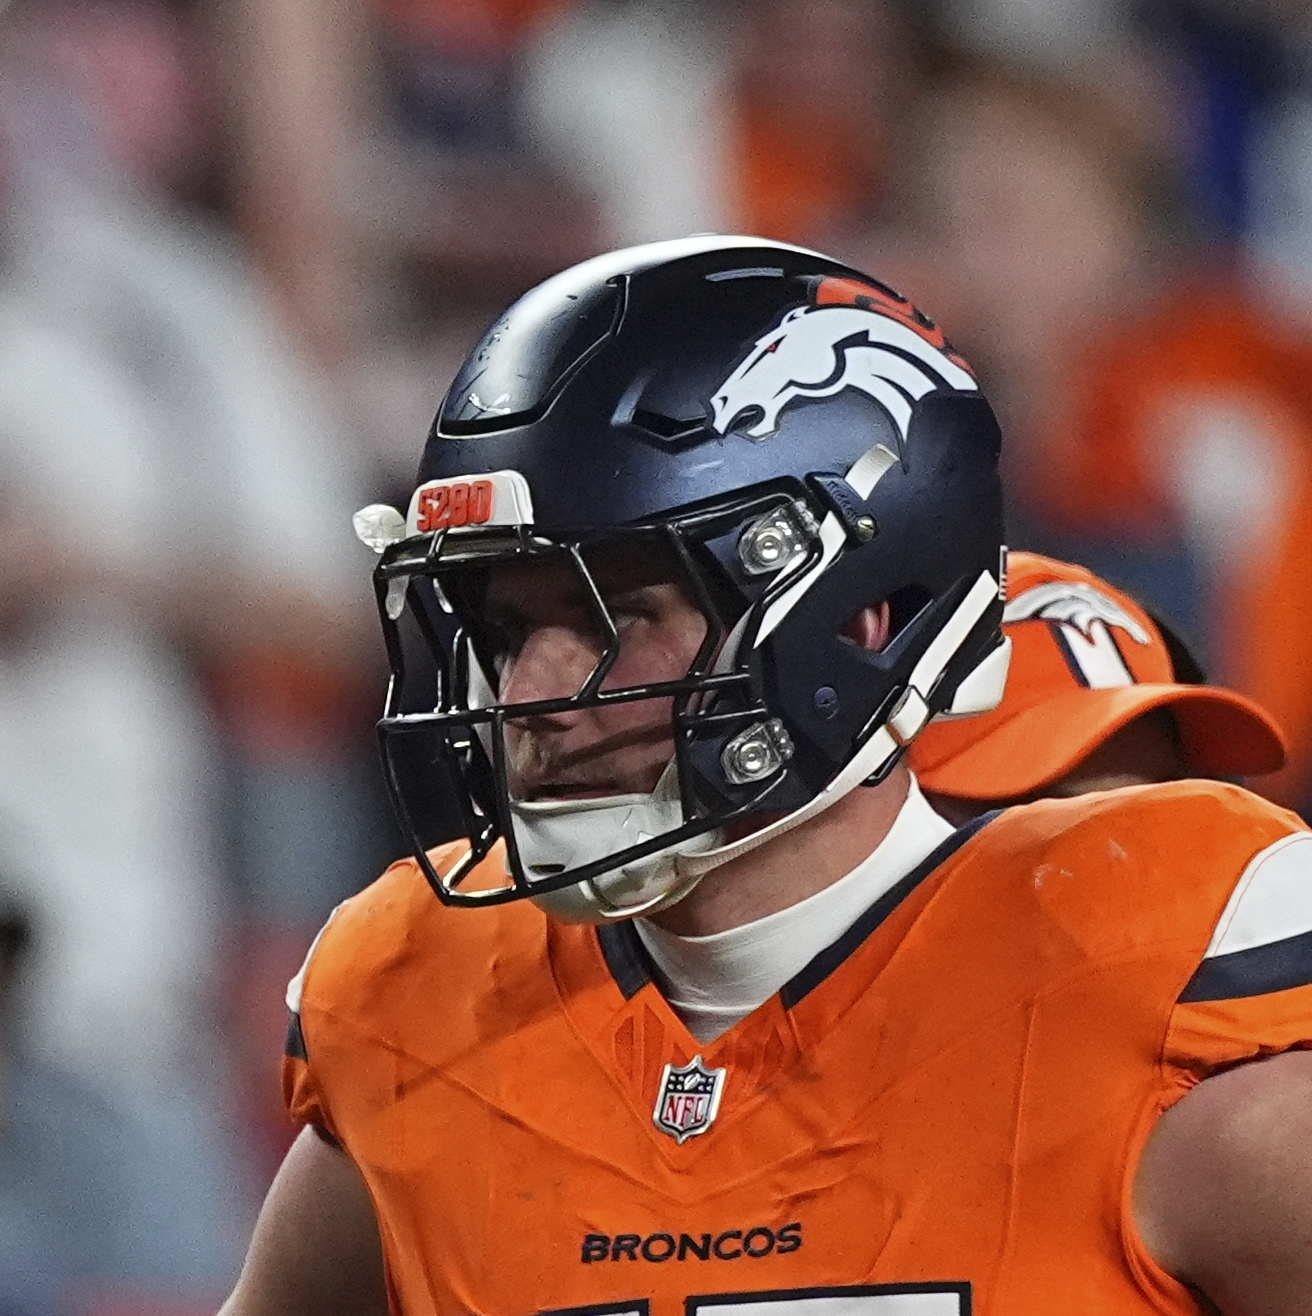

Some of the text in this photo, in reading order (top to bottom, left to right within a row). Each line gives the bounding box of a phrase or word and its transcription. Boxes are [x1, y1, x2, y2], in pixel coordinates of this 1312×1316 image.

[417, 480, 493, 532] 5280
[662, 1094, 705, 1127] NFL
[581, 1222, 802, 1264] BRONCOS
